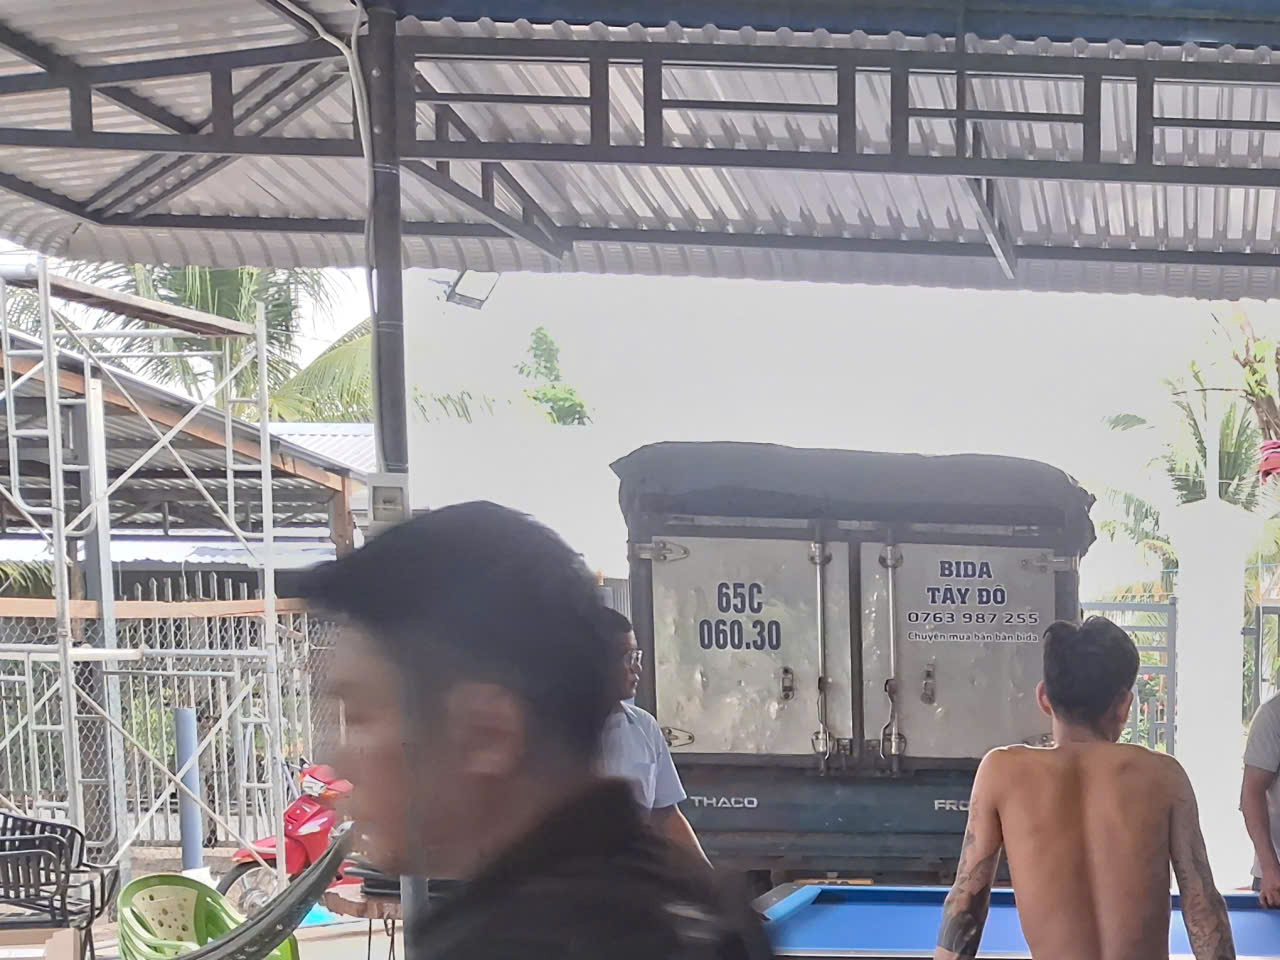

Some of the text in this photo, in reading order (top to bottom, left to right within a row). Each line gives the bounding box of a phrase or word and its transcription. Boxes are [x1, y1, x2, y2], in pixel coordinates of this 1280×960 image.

[939, 560, 993, 579] BIDA
[717, 581, 764, 614] 65C
[926, 583, 1006, 605] TÂY ĐÔ
[907, 612, 1039, 624] 0763 987 255
[699, 618, 782, 651] 060.30
[949, 633, 971, 641] mua
[690, 796, 759, 808] THACO
